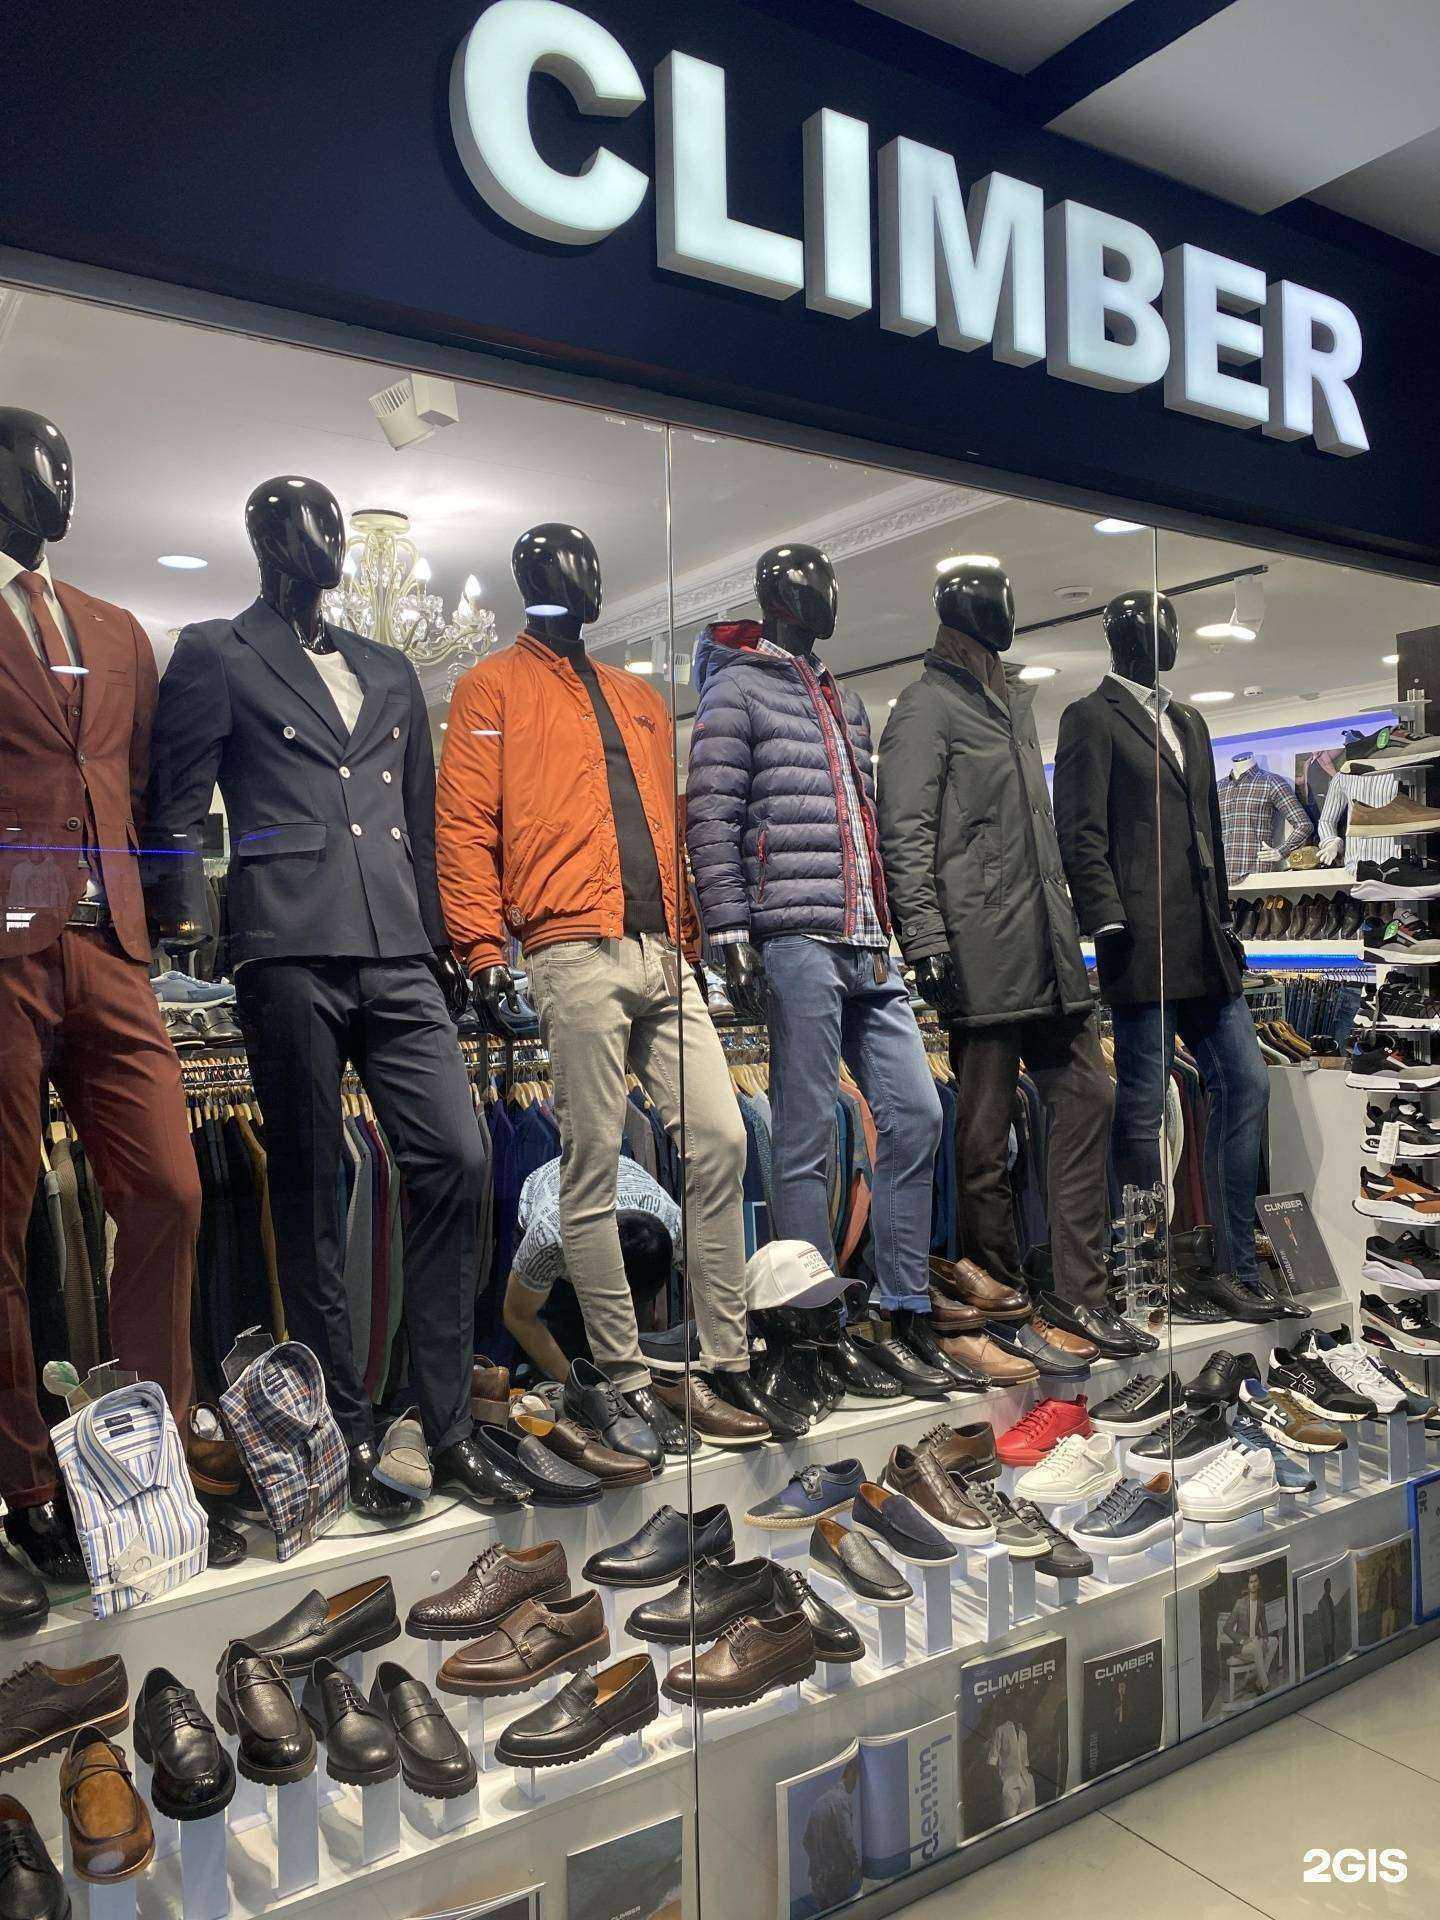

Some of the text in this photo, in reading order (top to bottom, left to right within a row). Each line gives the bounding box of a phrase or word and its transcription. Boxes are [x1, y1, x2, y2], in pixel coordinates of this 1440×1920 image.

[452, 0, 1369, 456] CLIMBER
[1263, 1199, 1303, 1212] CLIMBER
[973, 1659, 1056, 1696] CLIMBER
[1095, 1651, 1154, 1680] CLIMBER
